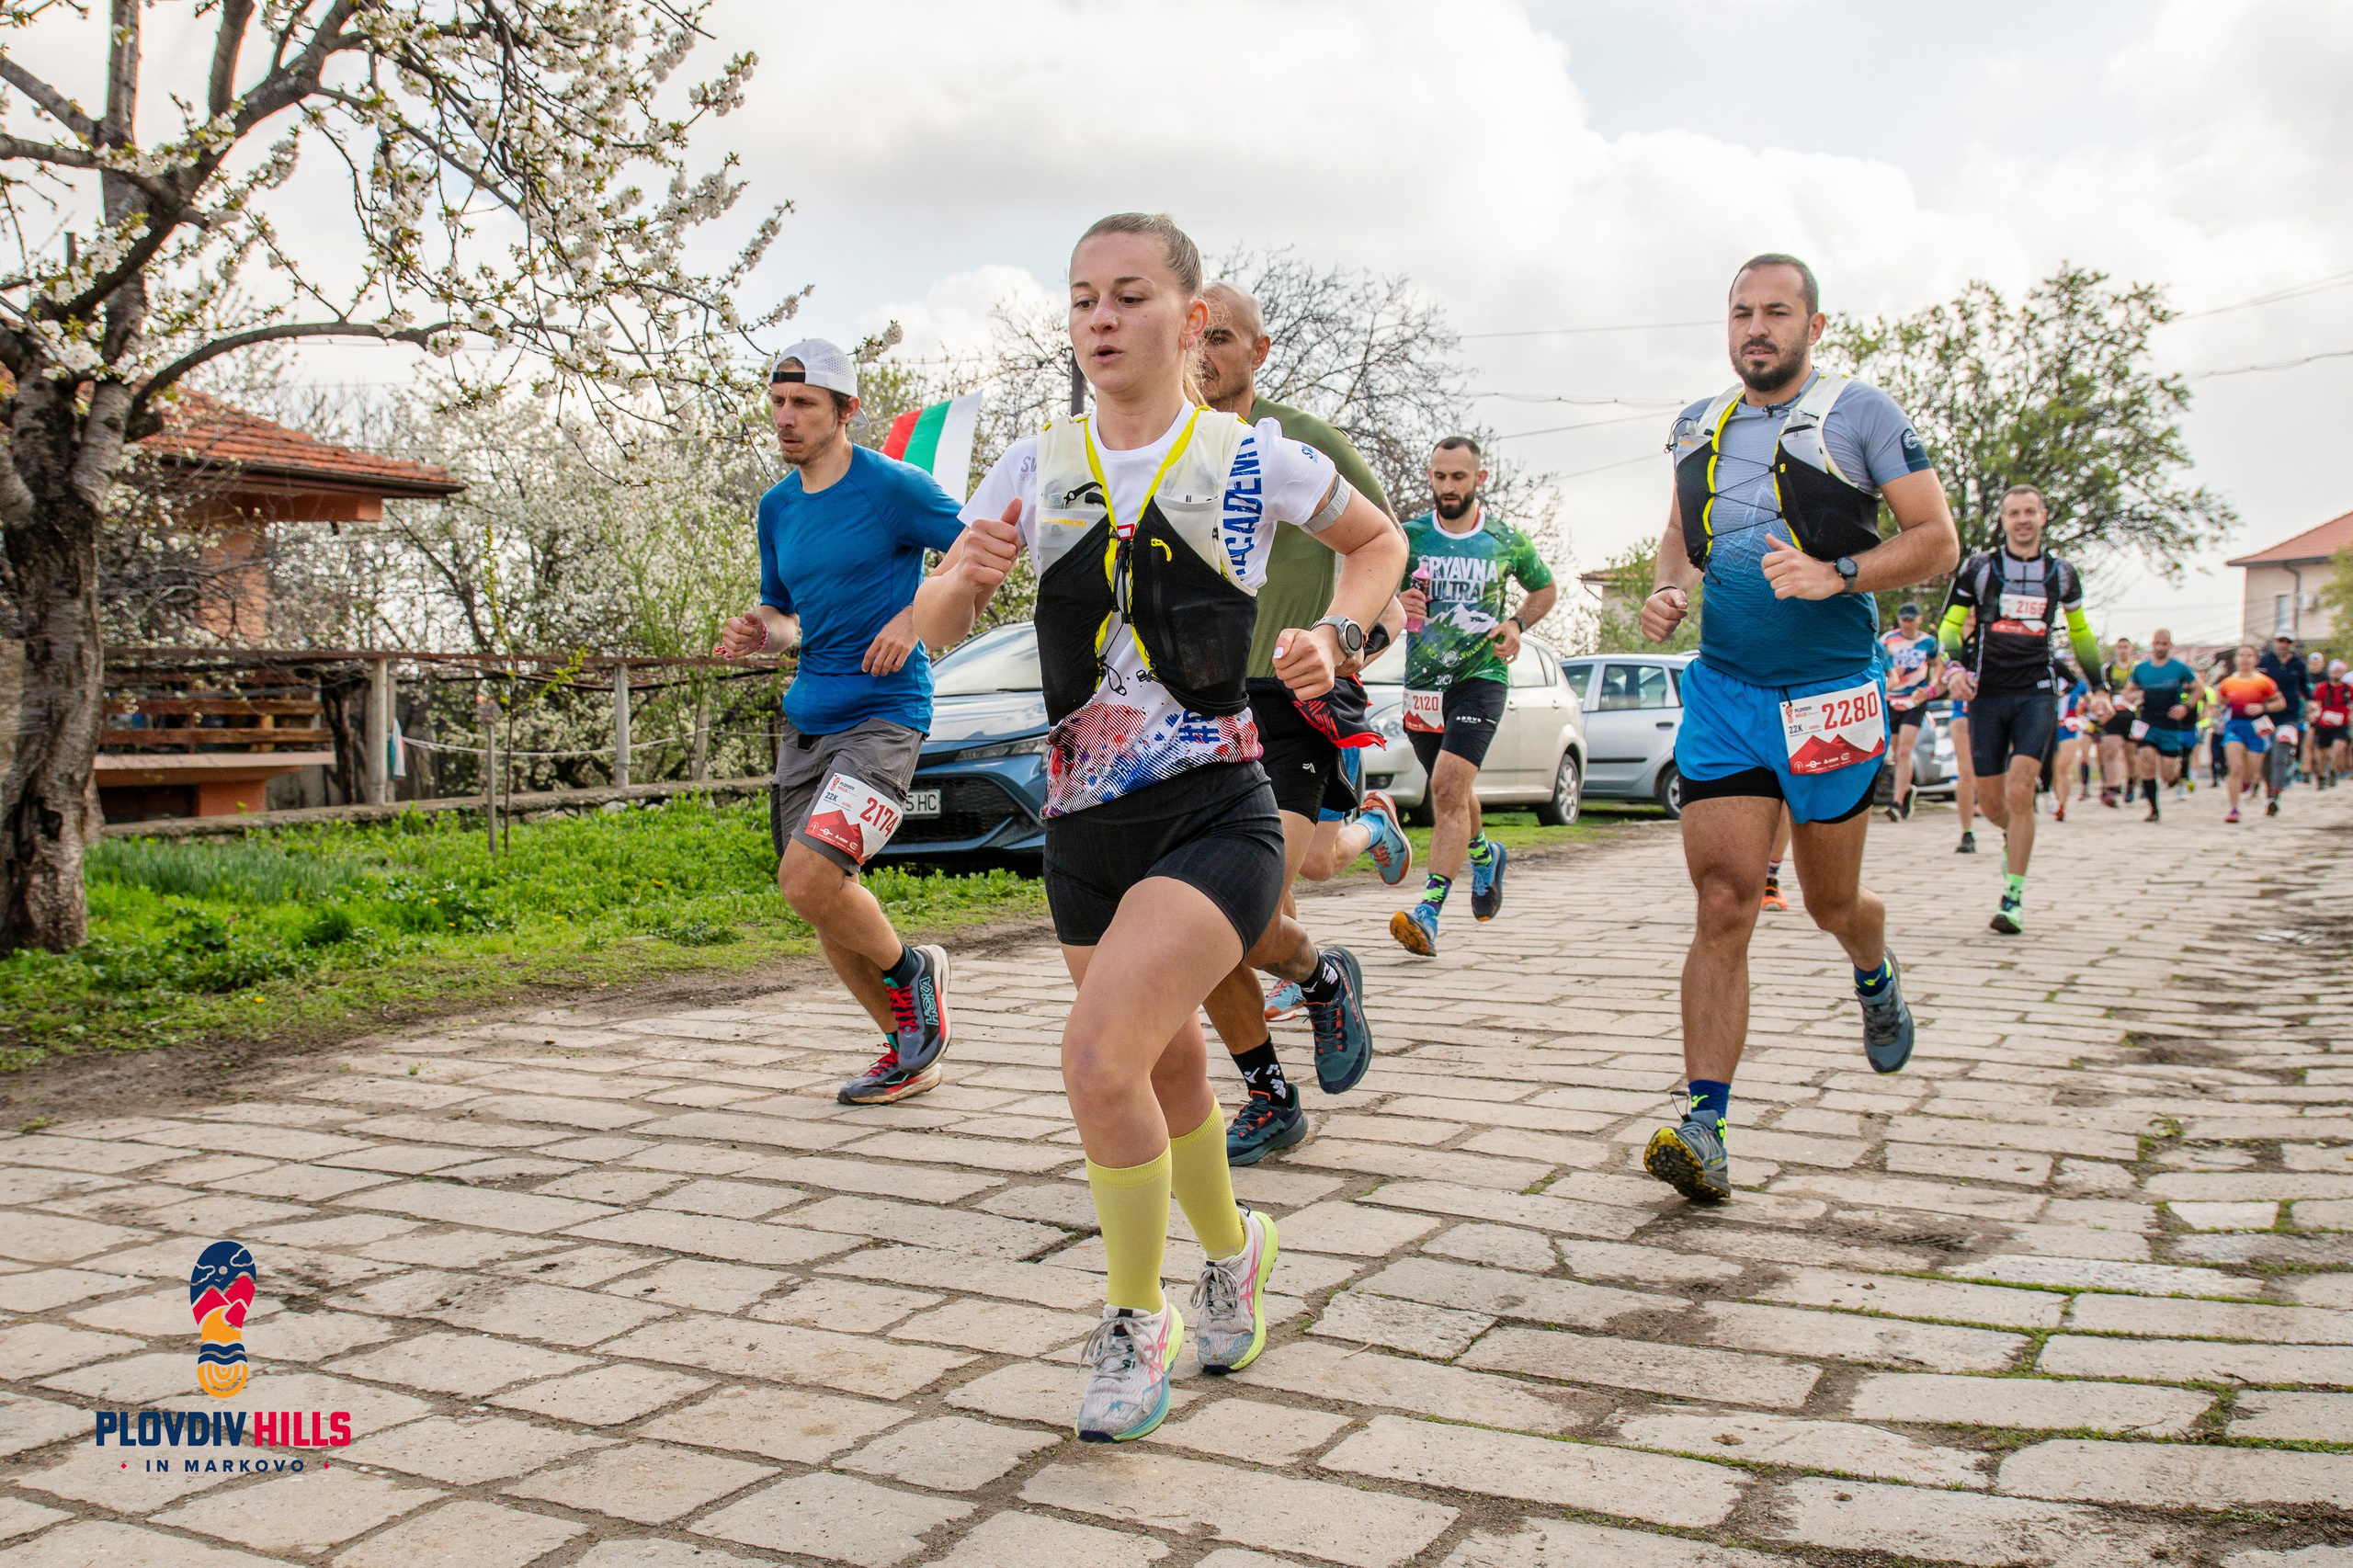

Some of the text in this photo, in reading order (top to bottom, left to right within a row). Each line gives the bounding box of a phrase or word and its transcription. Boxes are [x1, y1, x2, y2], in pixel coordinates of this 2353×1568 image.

[1040, 517, 1087, 528] LOMON
[1428, 555, 1499, 583] RYAVNA
[1431, 580, 1478, 601] ULTRA
[1413, 695, 1438, 711] 2120
[1822, 691, 1878, 730] 2280
[1789, 724, 1803, 733] 22K
[824, 791, 838, 802] 22K
[859, 797, 899, 837] 2174
[919, 976, 939, 1027] HOKA
